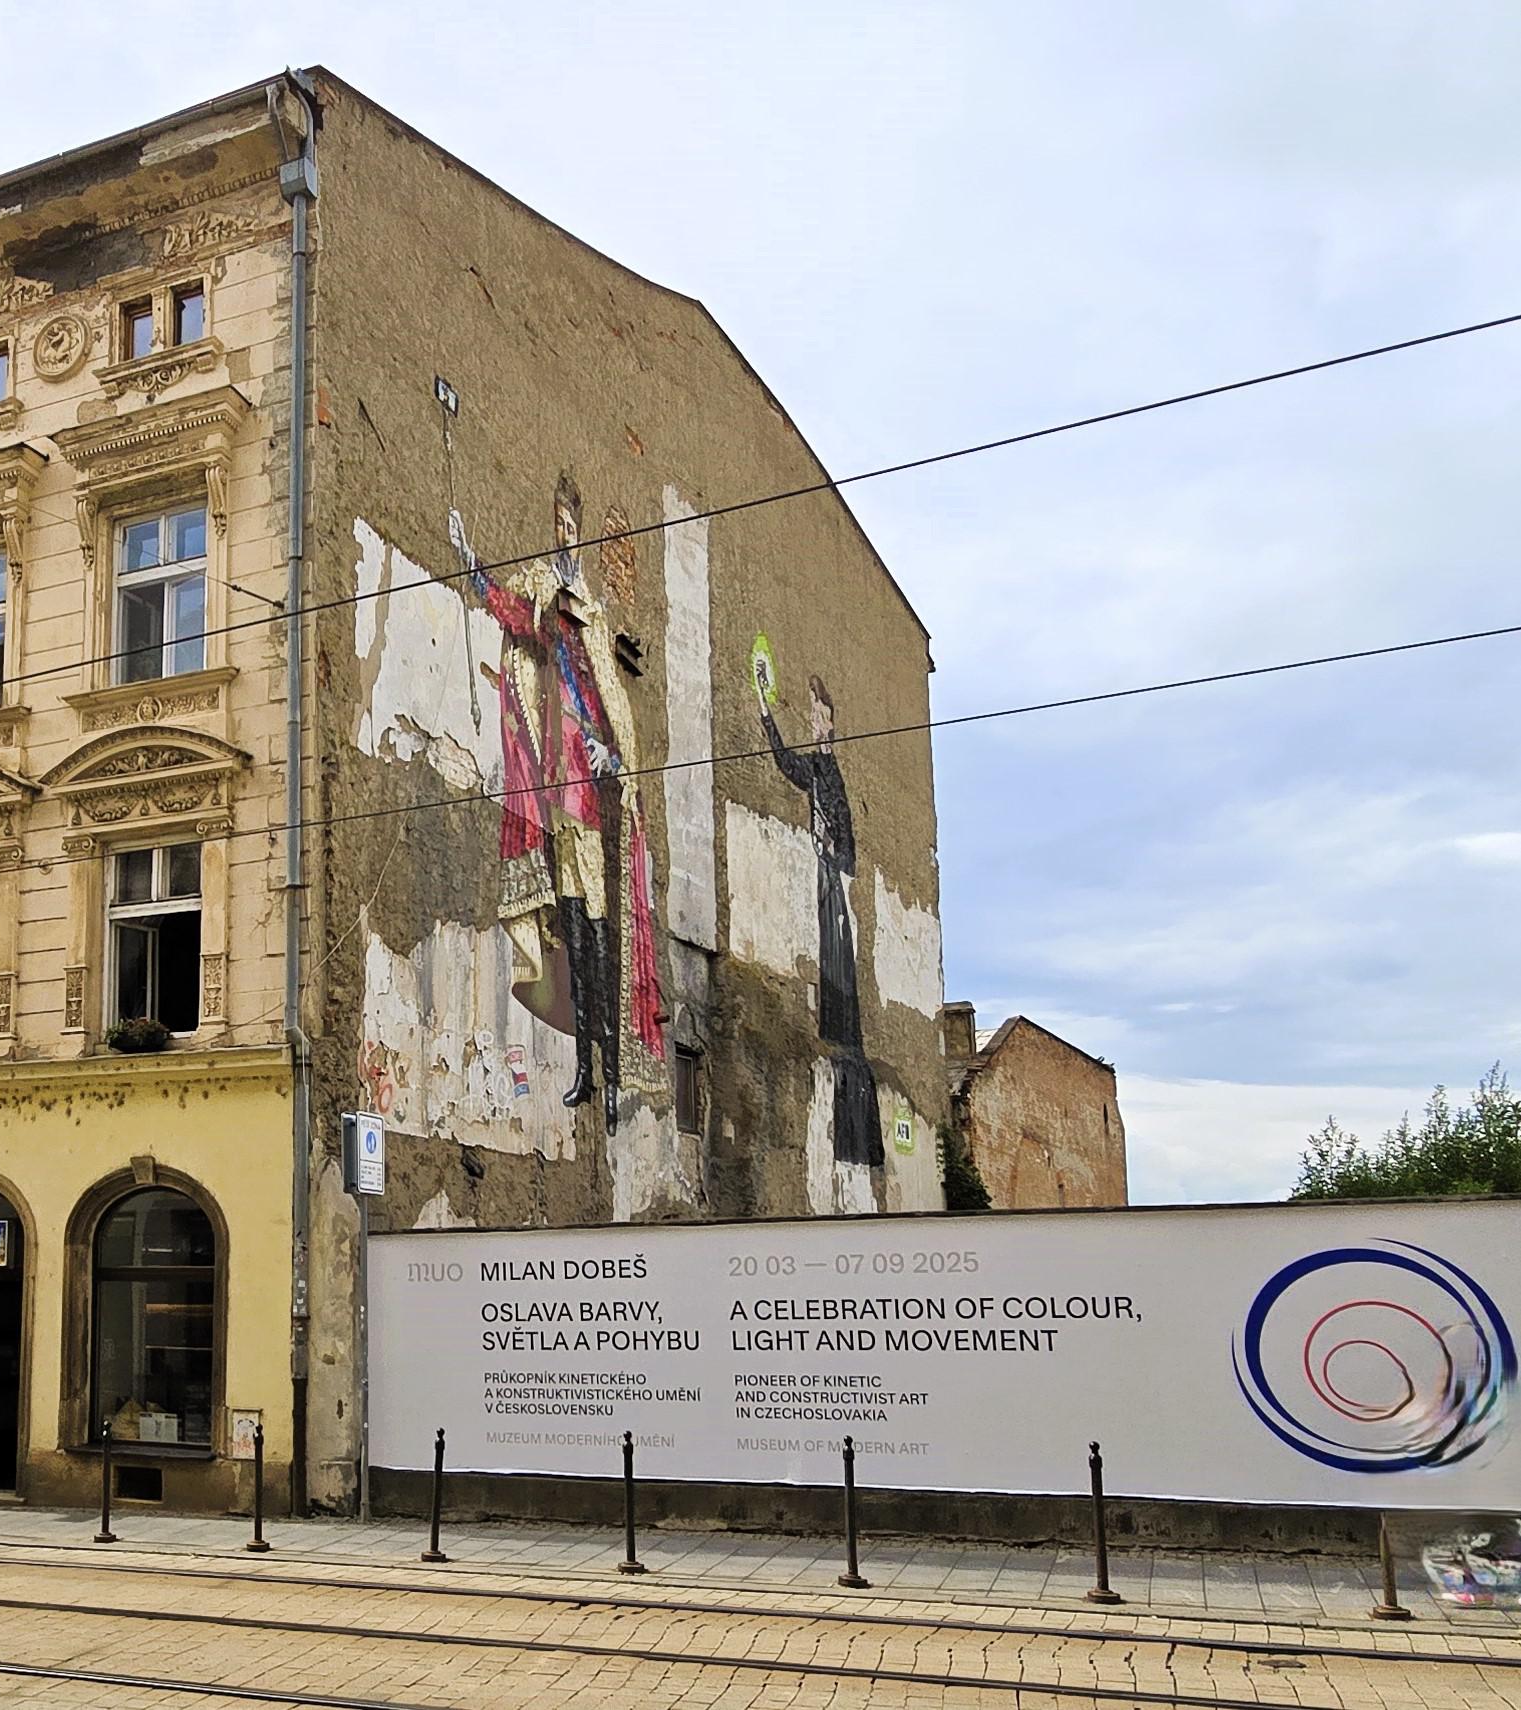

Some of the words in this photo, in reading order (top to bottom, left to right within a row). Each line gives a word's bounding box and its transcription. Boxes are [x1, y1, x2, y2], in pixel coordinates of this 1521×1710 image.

[480, 1260, 555, 1282] MILAN
[563, 1253, 648, 1280] DOBEŠ
[728, 1256, 758, 1277] 20
[765, 1256, 797, 1276] 03
[835, 1254, 864, 1275] 07
[872, 1253, 905, 1274] 09
[913, 1251, 980, 1273] 2025
[481, 1302, 573, 1323] OSLAVA
[579, 1301, 663, 1325] BARVY,
[730, 1300, 748, 1320] A
[754, 1298, 946, 1321] CELEBRATION
[955, 1297, 996, 1319] OF
[1002, 1296, 1143, 1323] COLOUR,
[482, 1326, 569, 1351] SVĚTLA
[573, 1331, 590, 1350] A
[597, 1330, 700, 1351] POHYBU
[731, 1330, 809, 1351] LIGHT
[815, 1330, 876, 1351] AND
[885, 1329, 1059, 1352] MOVEMENT
[484, 1369, 556, 1384] PRŮKOPNÍK
[559, 1371, 647, 1385] KINETICKÉHO
[734, 1374, 797, 1387] PIONEER
[800, 1375, 820, 1387] OF
[824, 1375, 882, 1388] KINETIC
[484, 1388, 494, 1399] A
[496, 1386, 653, 1401] KONSTRUKTIVISTICKÉHO
[655, 1386, 702, 1402] UMĚNÍ
[734, 1391, 766, 1403] AND
[769, 1391, 896, 1405] CONSTRUCTIVIST
[899, 1393, 929, 1405] ART
[485, 1403, 494, 1414] V
[495, 1401, 614, 1416] ČESKOSLOVENSKU
[736, 1407, 751, 1419] IN
[754, 1407, 888, 1421] CZECHOSLOVAKIA
[486, 1431, 542, 1445] MUZEUM
[736, 1438, 801, 1452] MUSEUM
[804, 1439, 824, 1452] OF
[828, 1440, 896, 1455] MDERN
[899, 1442, 930, 1456] ART
